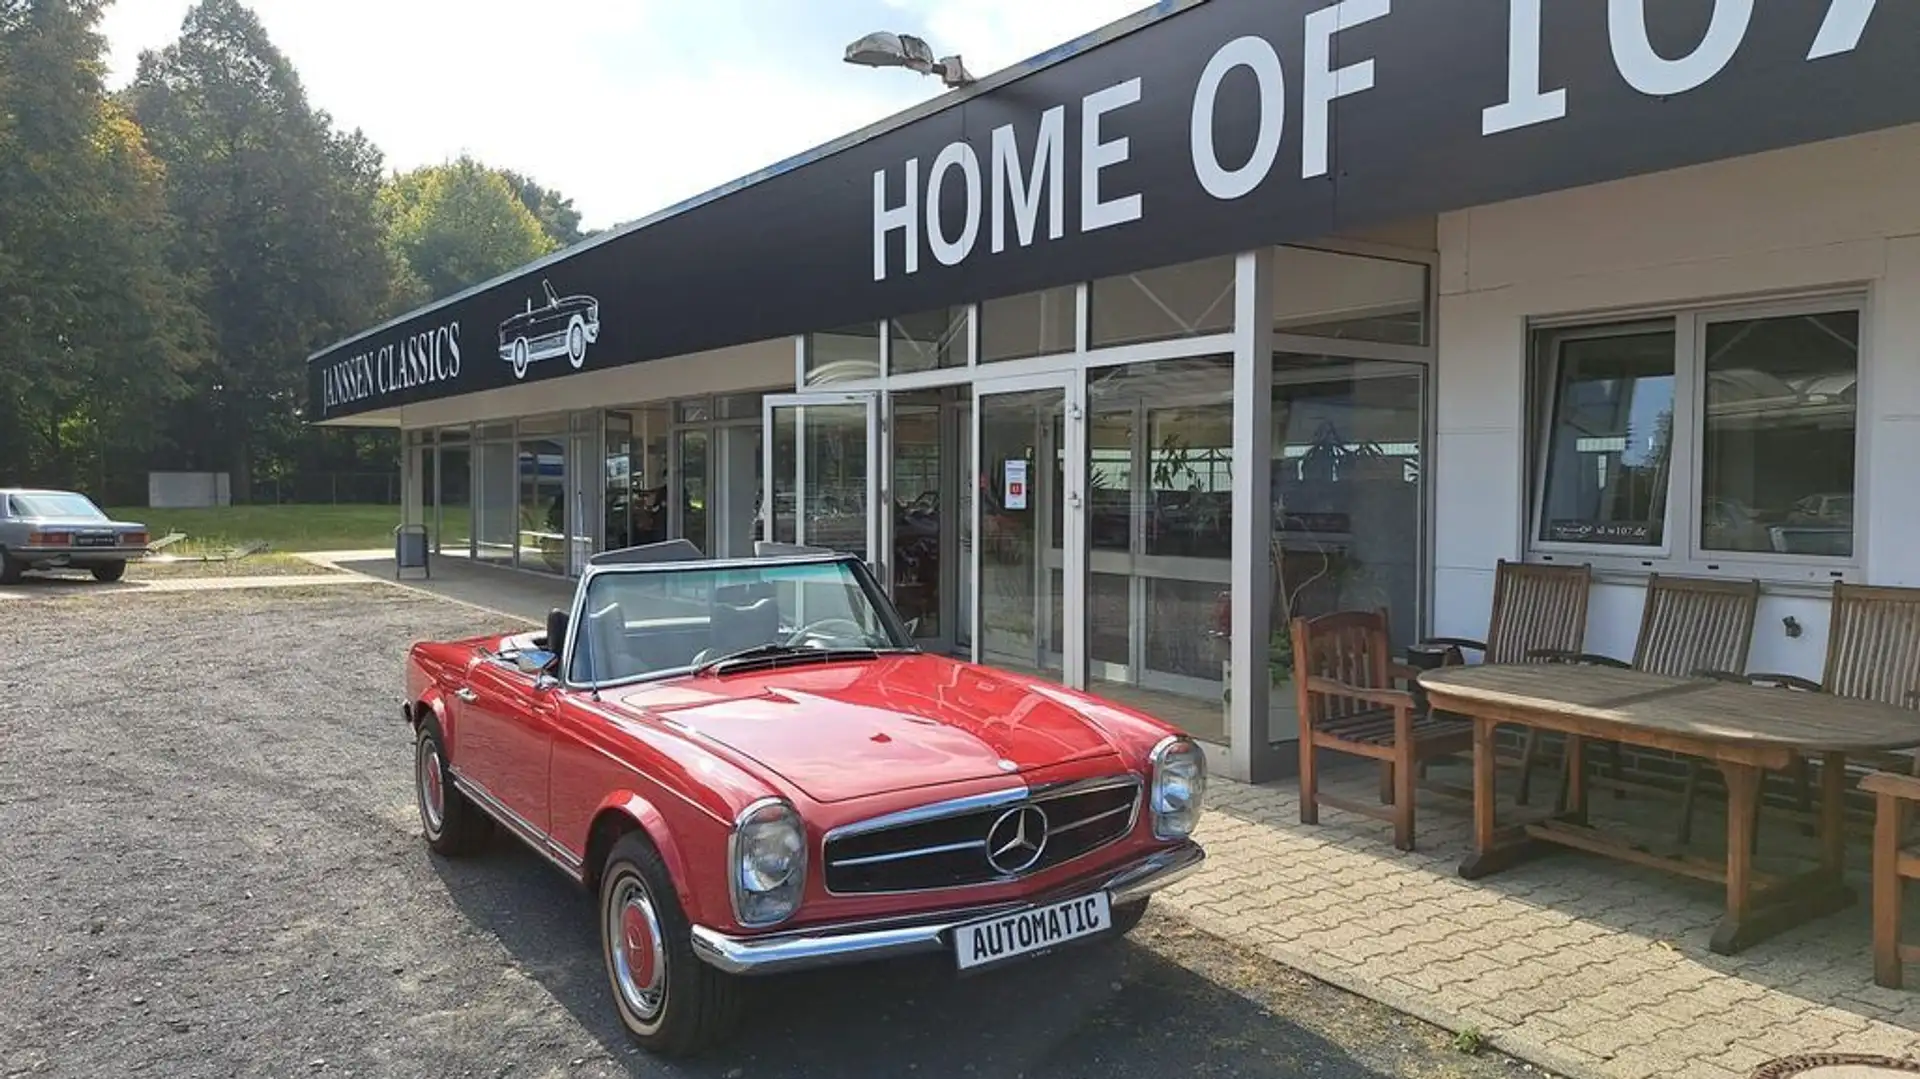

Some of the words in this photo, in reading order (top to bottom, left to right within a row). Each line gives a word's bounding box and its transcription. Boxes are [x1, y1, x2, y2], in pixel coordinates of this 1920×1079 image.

[874, 77, 1143, 281] HOME
[1191, 0, 1391, 200] OF
[323, 351, 374, 414] JANSSEN
[378, 321, 460, 393] CLASSICS
[973, 898, 1099, 961] AUTOMATIC
